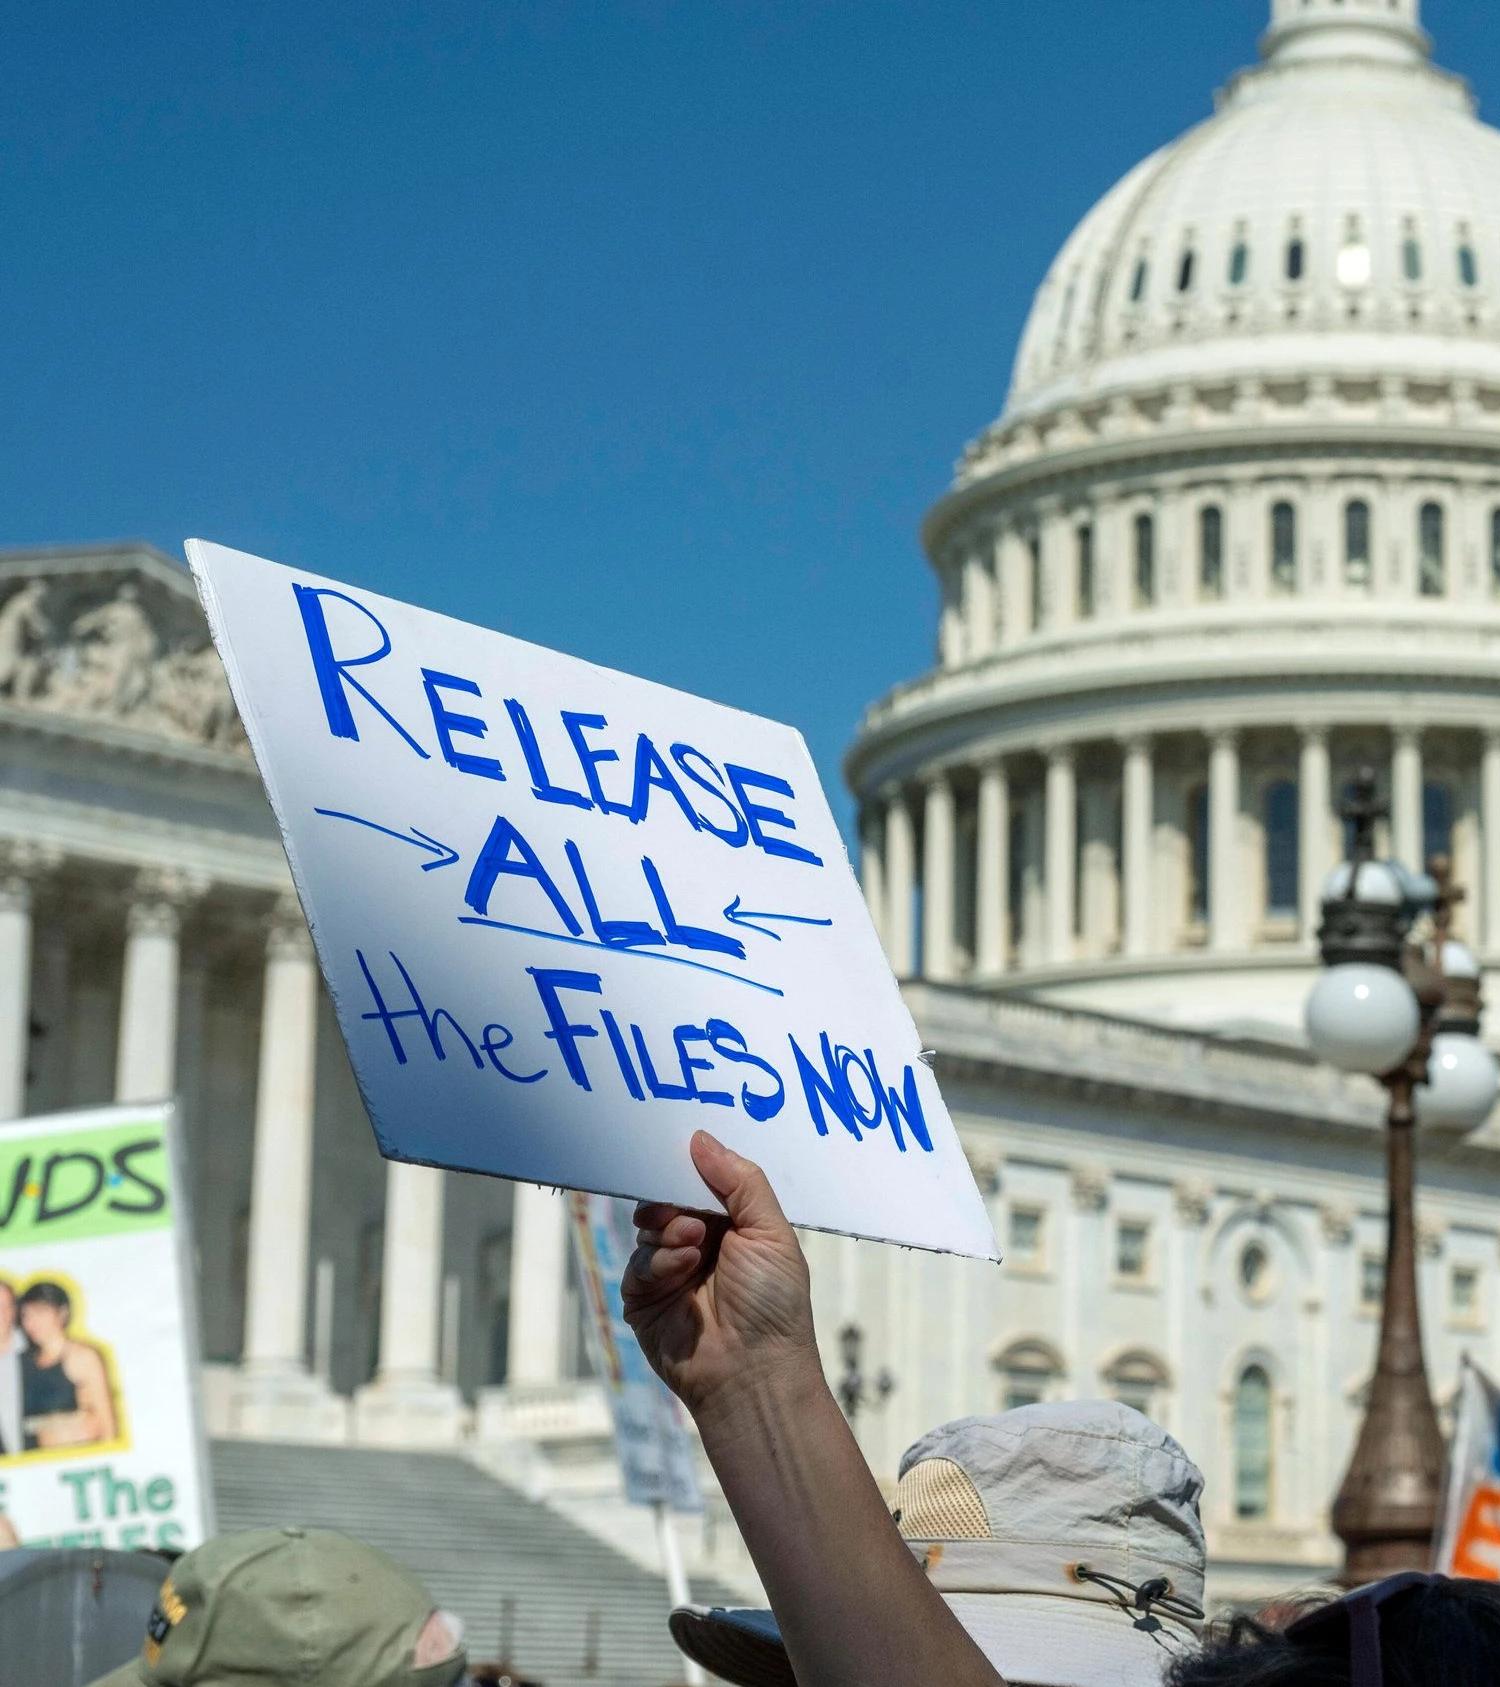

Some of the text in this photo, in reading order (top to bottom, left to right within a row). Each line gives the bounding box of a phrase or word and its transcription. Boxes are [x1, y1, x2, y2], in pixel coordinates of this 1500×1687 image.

[292, 582, 824, 868] RELEASE
[463, 815, 747, 961] ALL
[355, 949, 935, 1154] the FILES NOW
[59, 1465, 175, 1522] The
